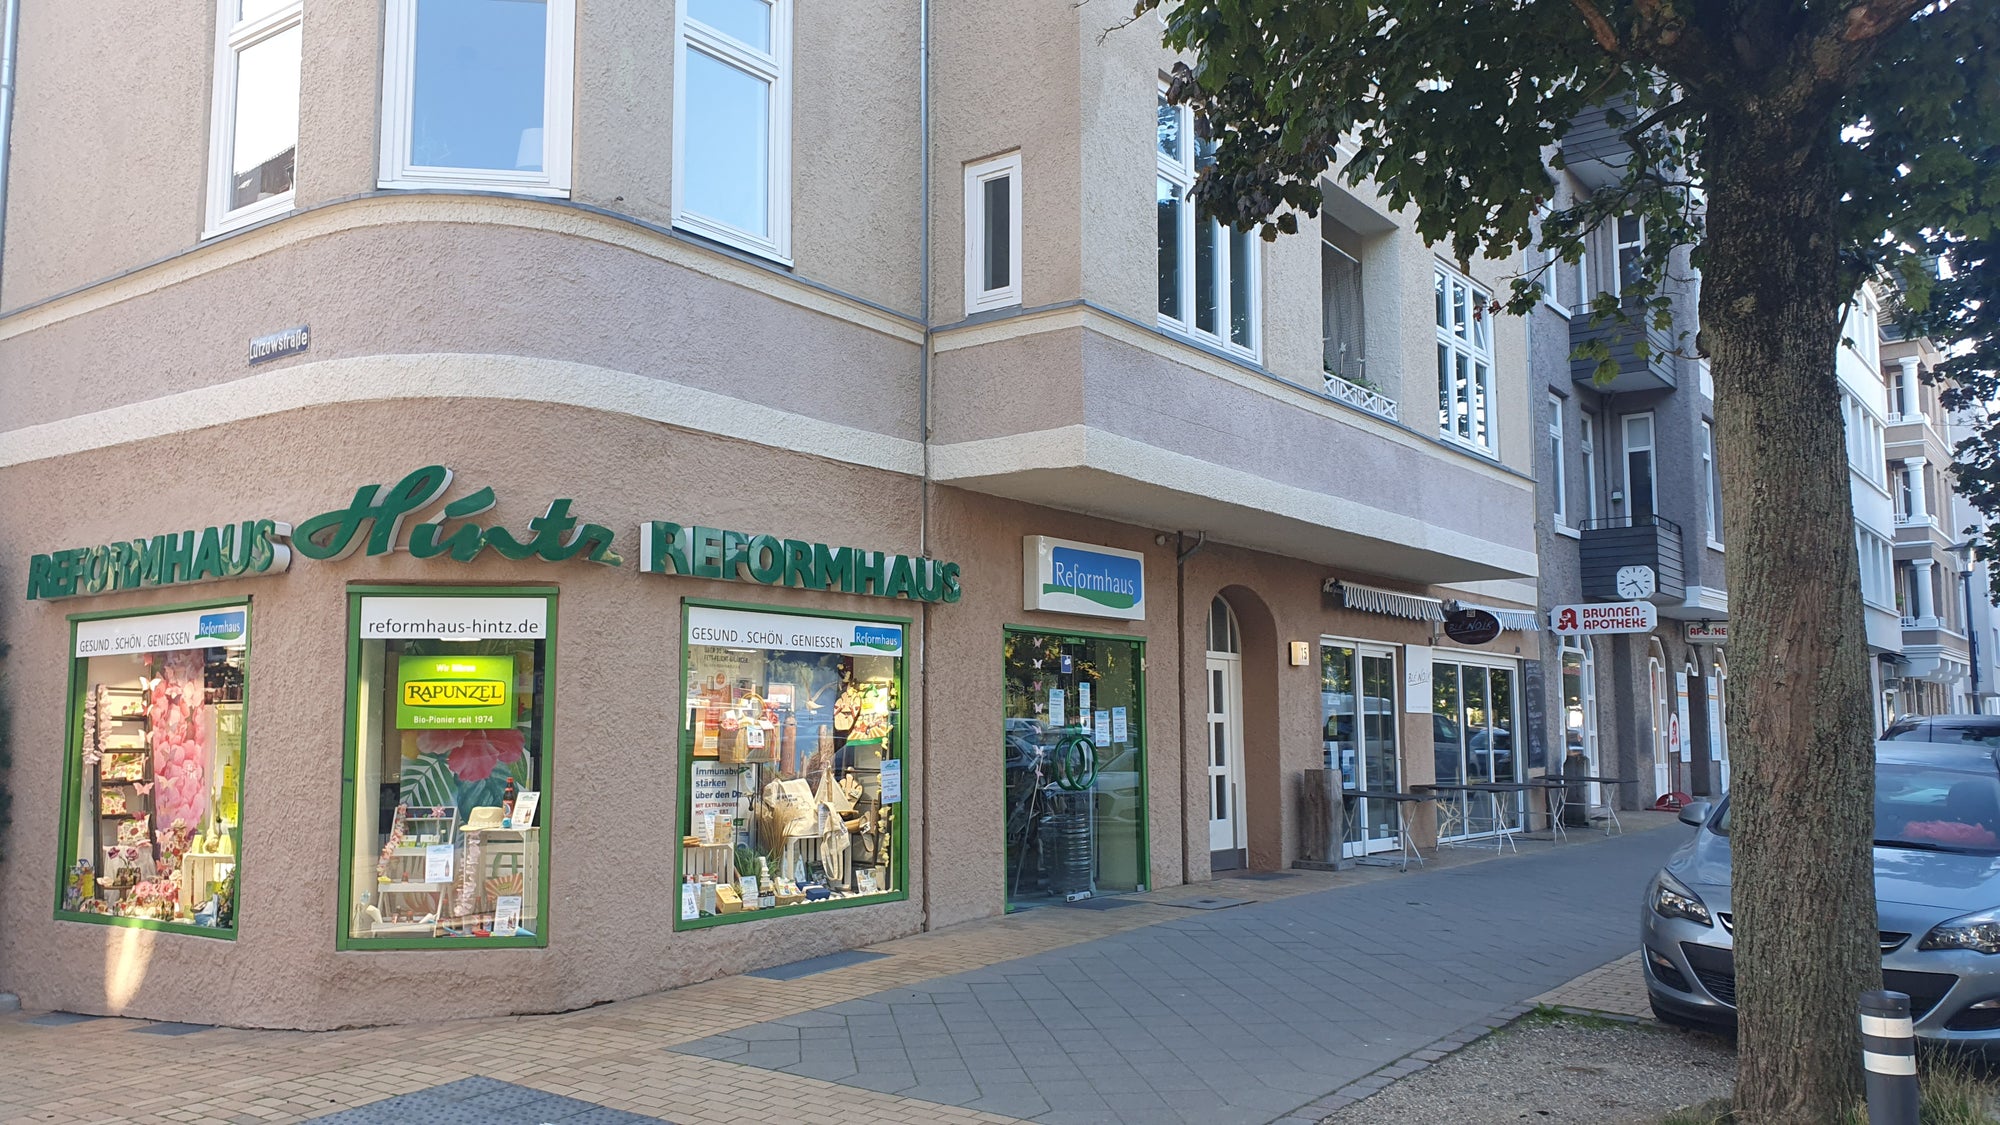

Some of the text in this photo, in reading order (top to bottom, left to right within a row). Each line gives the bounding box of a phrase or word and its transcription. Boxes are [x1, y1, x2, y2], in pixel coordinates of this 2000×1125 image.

[26, 465, 625, 601] REFORMHAUS Hintz
[650, 520, 962, 603] REFORMHAUS
[1055, 561, 1134, 596] Reformhaus
[200, 620, 241, 638] Reformhaus
[368, 618, 539, 634] reformhaus-hintz.de
[1583, 617, 1647, 631] APOTHEKE
[79, 638, 110, 653] GESUND
[115, 633, 142, 650] SCHÖN
[147, 631, 190, 647] GENIESSEN
[691, 627, 738, 643] GESUND
[747, 630, 783, 645] SCHÖN
[791, 634, 843, 649] GENIESSEN
[855, 631, 898, 646] Reformhaus
[1300, 647, 1308, 660] 15
[407, 685, 502, 702] RAPUNZEL
[413, 714, 494, 724] Bio-Pionier seit 1974
[695, 779, 727, 788] stärken
[695, 791, 713, 799] über
[715, 791, 730, 799] den
